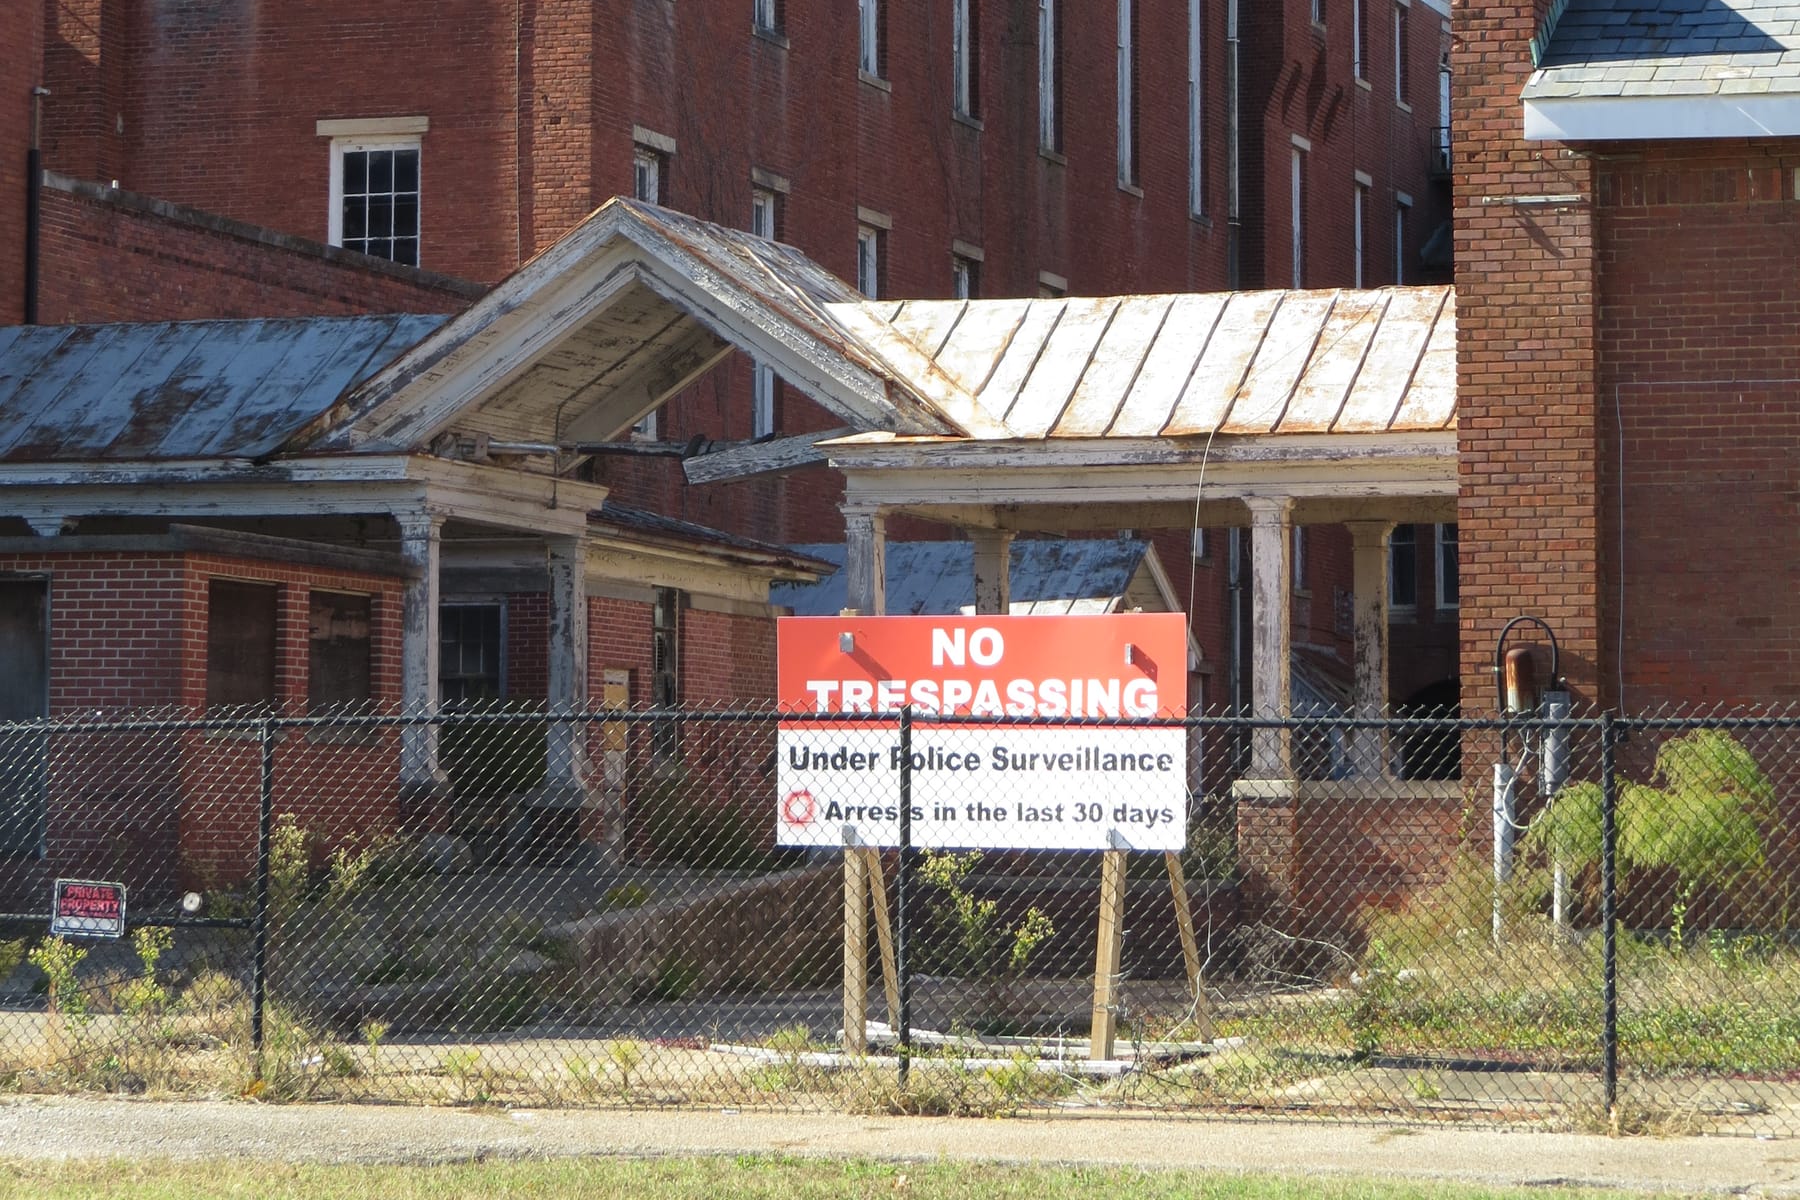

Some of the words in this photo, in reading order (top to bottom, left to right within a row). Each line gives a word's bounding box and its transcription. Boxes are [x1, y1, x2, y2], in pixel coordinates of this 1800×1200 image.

[932, 628, 1004, 666] NO
[806, 678, 1159, 719] TRESPASSING
[789, 746, 880, 772] Under
[992, 746, 1174, 773] Surveillance
[824, 800, 924, 822] Arress
[934, 801, 962, 822] in
[967, 801, 1007, 822] the
[1017, 802, 1064, 822] last
[1072, 802, 1103, 822] 30
[1112, 803, 1174, 829] days
[60, 898, 119, 912] PROPERTY
[67, 885, 114, 899] PRIVATE
